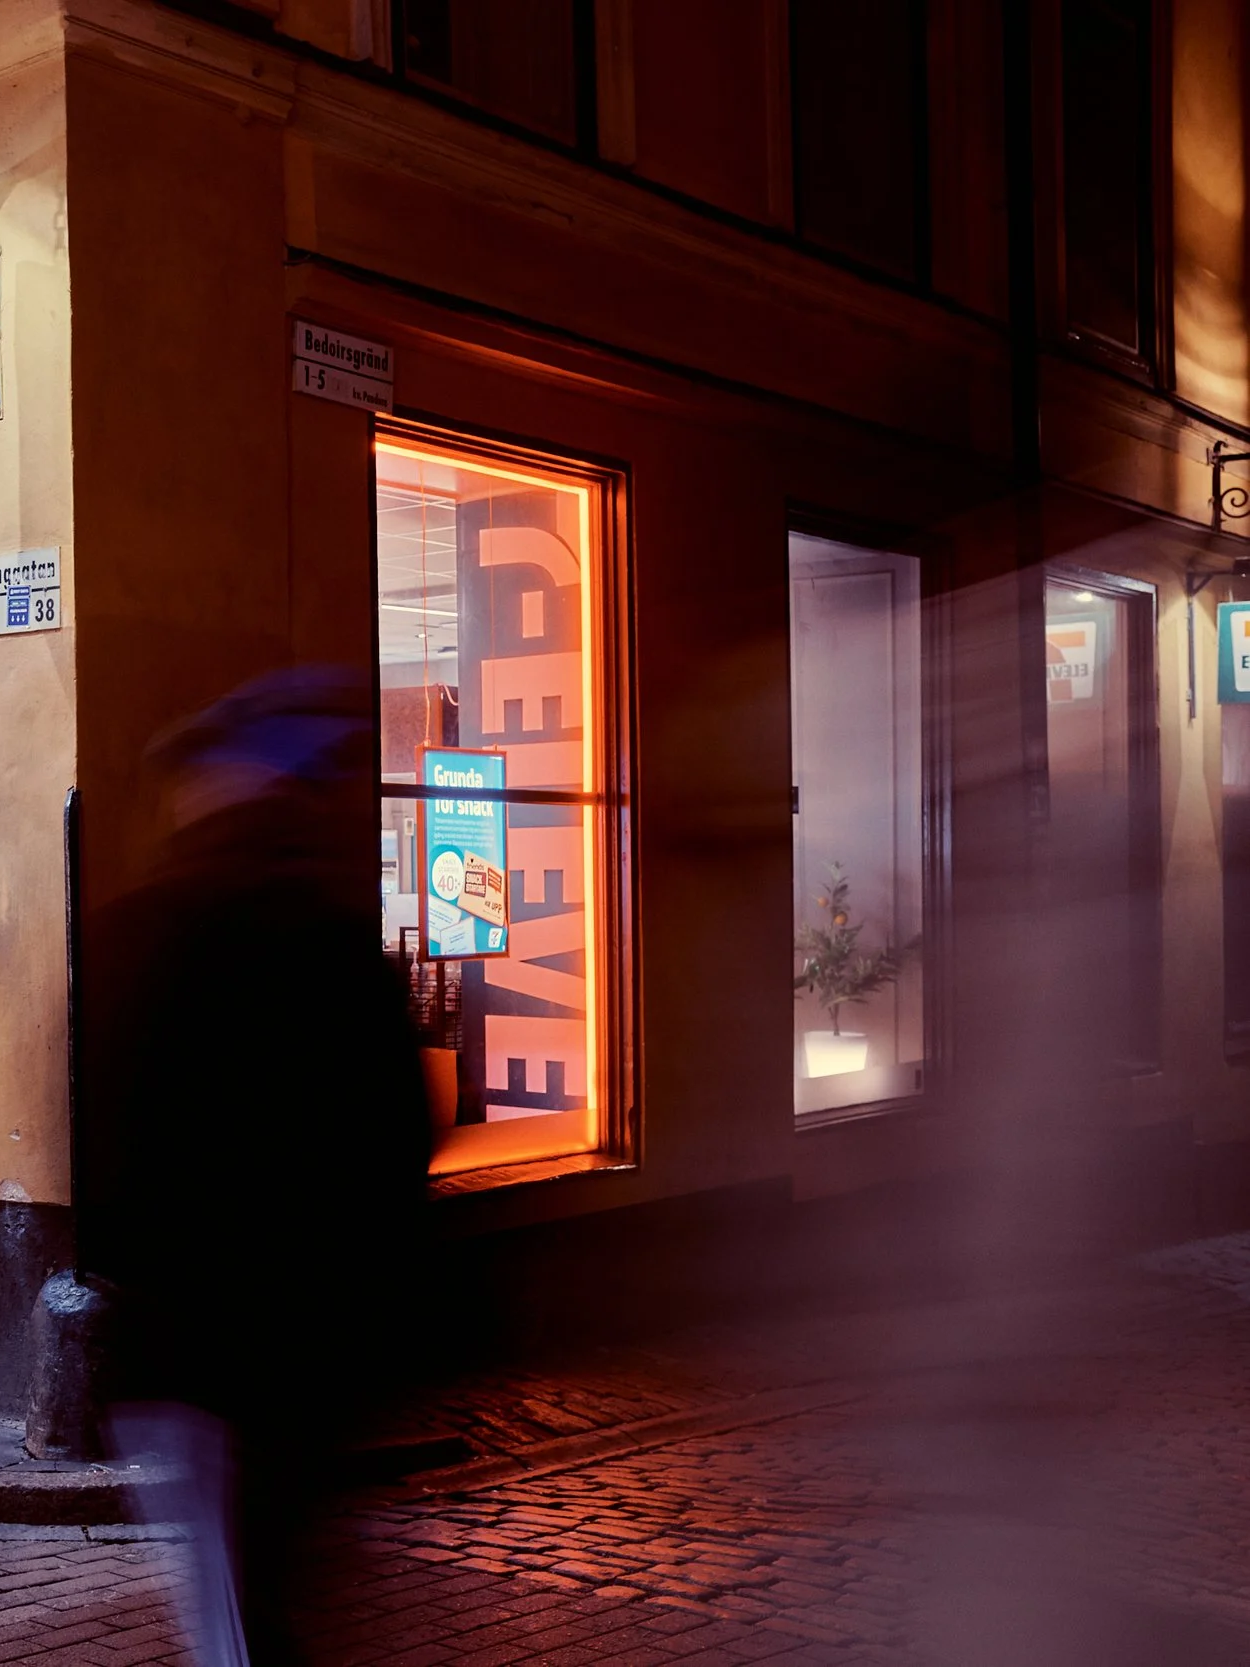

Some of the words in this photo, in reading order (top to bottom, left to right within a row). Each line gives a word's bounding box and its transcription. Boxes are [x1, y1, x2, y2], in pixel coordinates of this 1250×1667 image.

[305, 329, 388, 371] Bedoirsgränd
[35, 598, 55, 622] 38
[434, 764, 483, 788] Grunda
